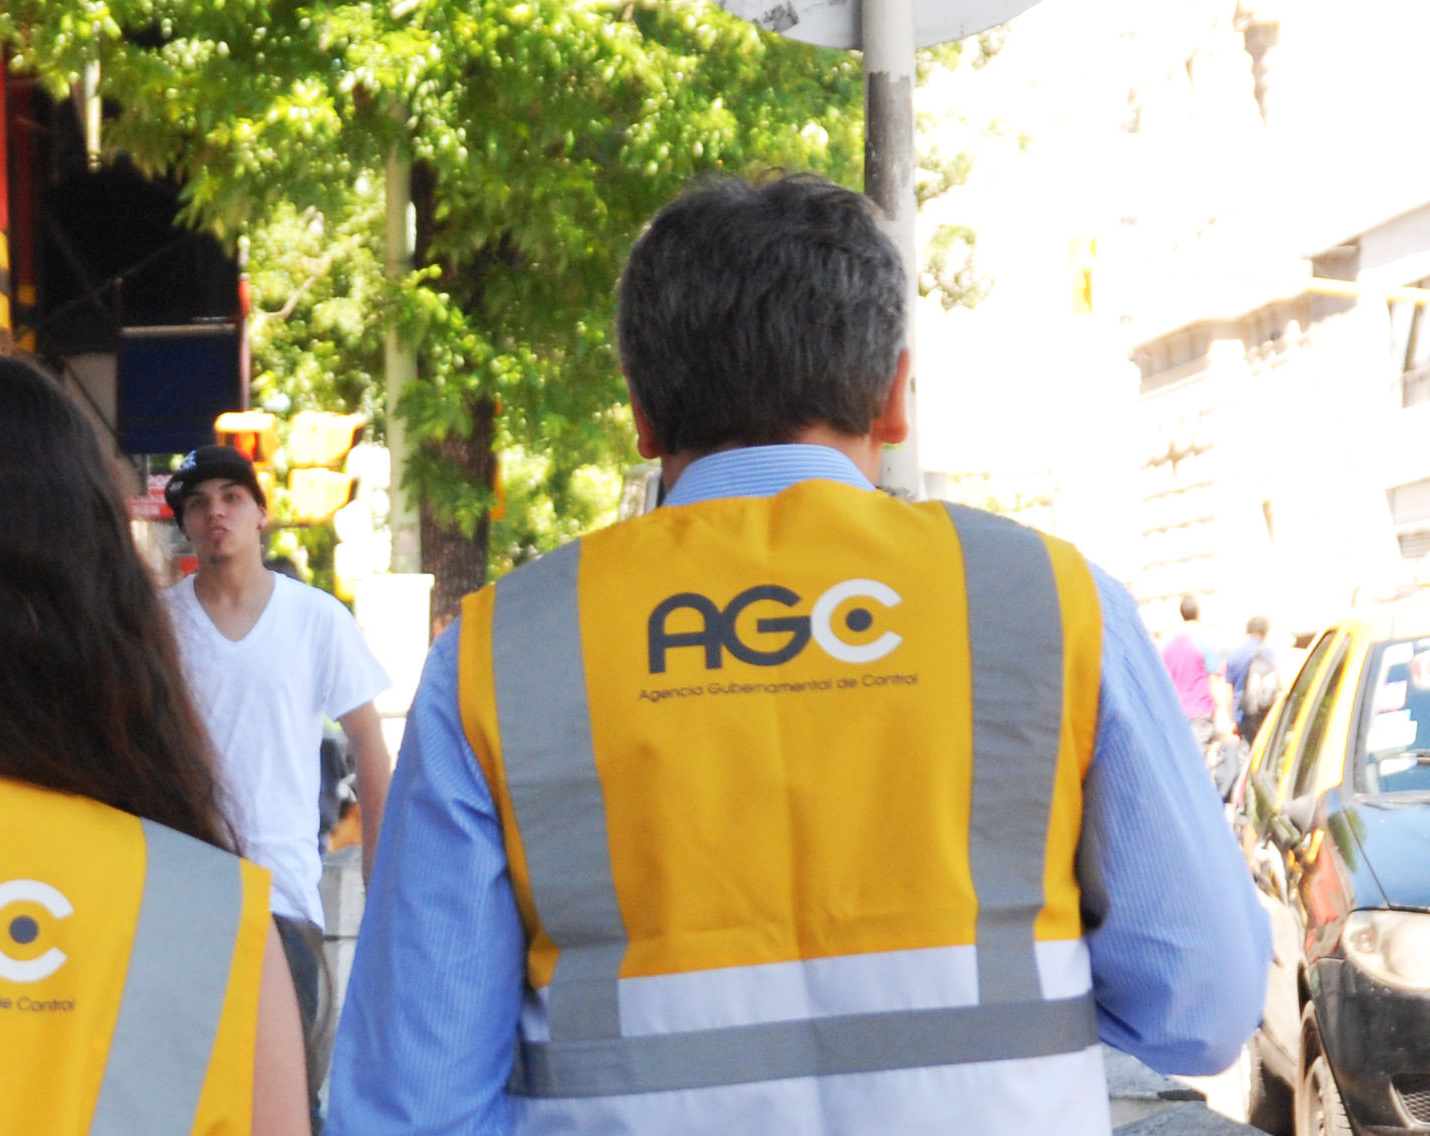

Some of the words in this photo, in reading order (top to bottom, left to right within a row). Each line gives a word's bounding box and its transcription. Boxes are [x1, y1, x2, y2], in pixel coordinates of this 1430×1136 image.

[647, 578, 904, 674] AGC
[638, 686, 704, 703] Agencia
[707, 678, 832, 696] Gubernamental
[836, 676, 858, 690] de
[861, 672, 918, 688] Control
[16, 997, 75, 1012] Control
